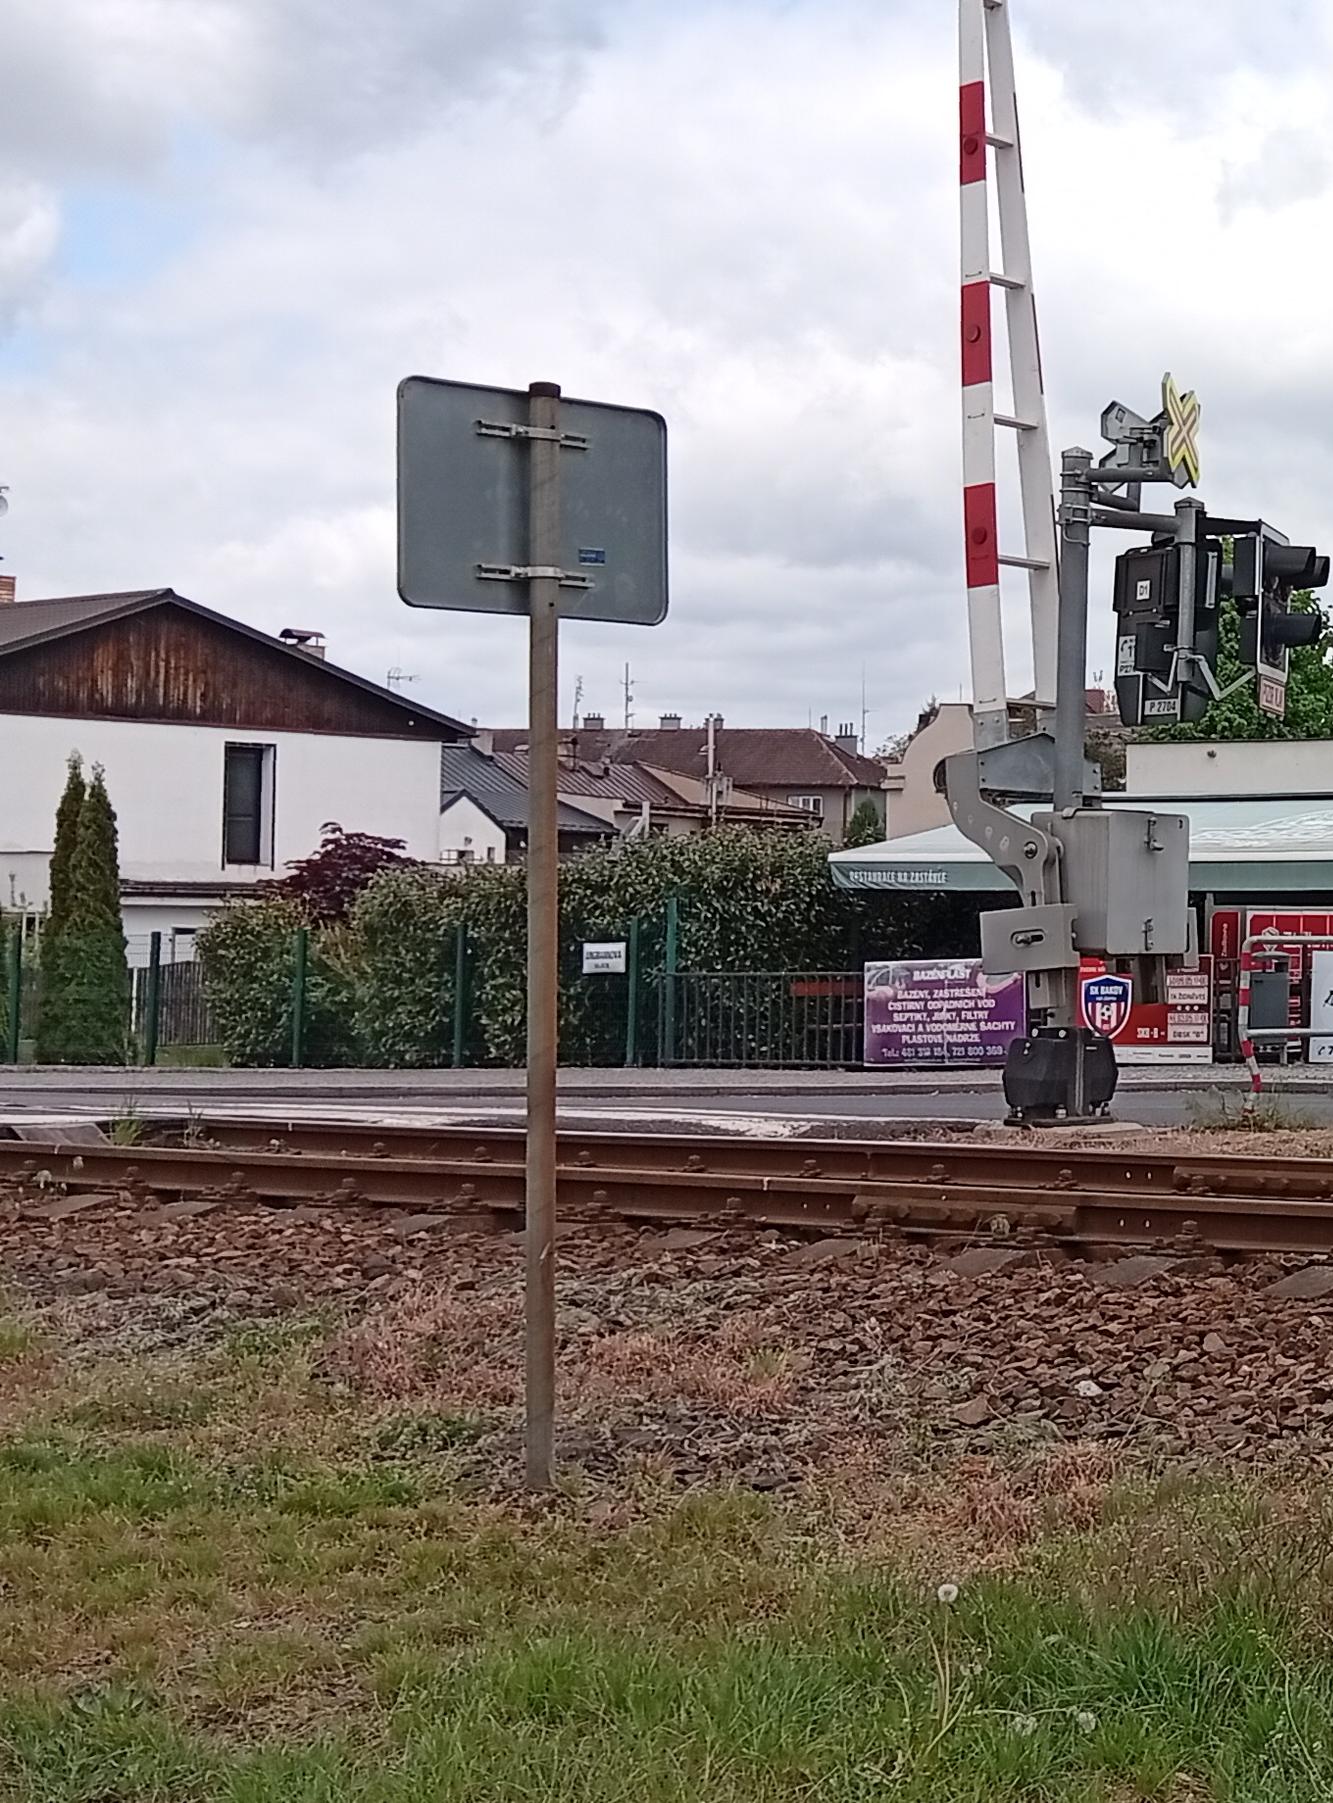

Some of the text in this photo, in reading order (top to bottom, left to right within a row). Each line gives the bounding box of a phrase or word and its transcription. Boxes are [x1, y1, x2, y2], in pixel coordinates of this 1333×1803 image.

[1138, 584, 1149, 596] D1
[1150, 701, 1176, 712] P 2704
